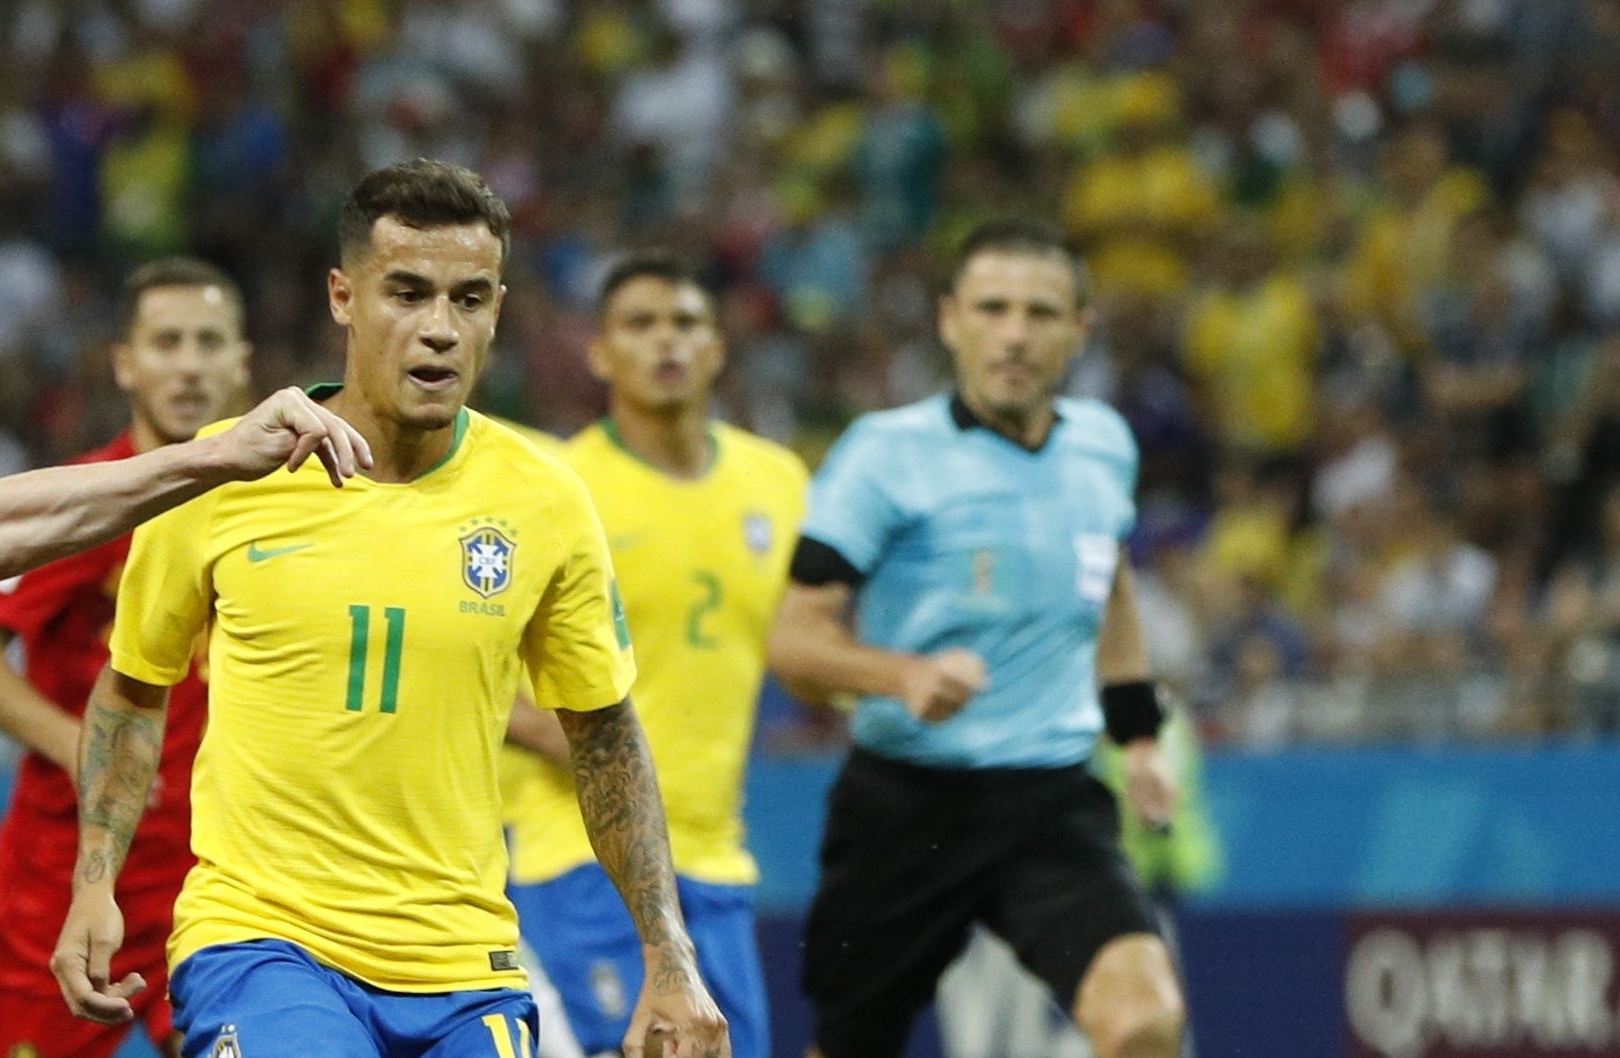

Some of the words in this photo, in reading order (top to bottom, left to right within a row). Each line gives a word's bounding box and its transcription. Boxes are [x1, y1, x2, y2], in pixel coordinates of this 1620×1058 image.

[460, 601, 505, 616] BRASIL
[686, 570, 723, 649] 2
[345, 604, 405, 714] 11
